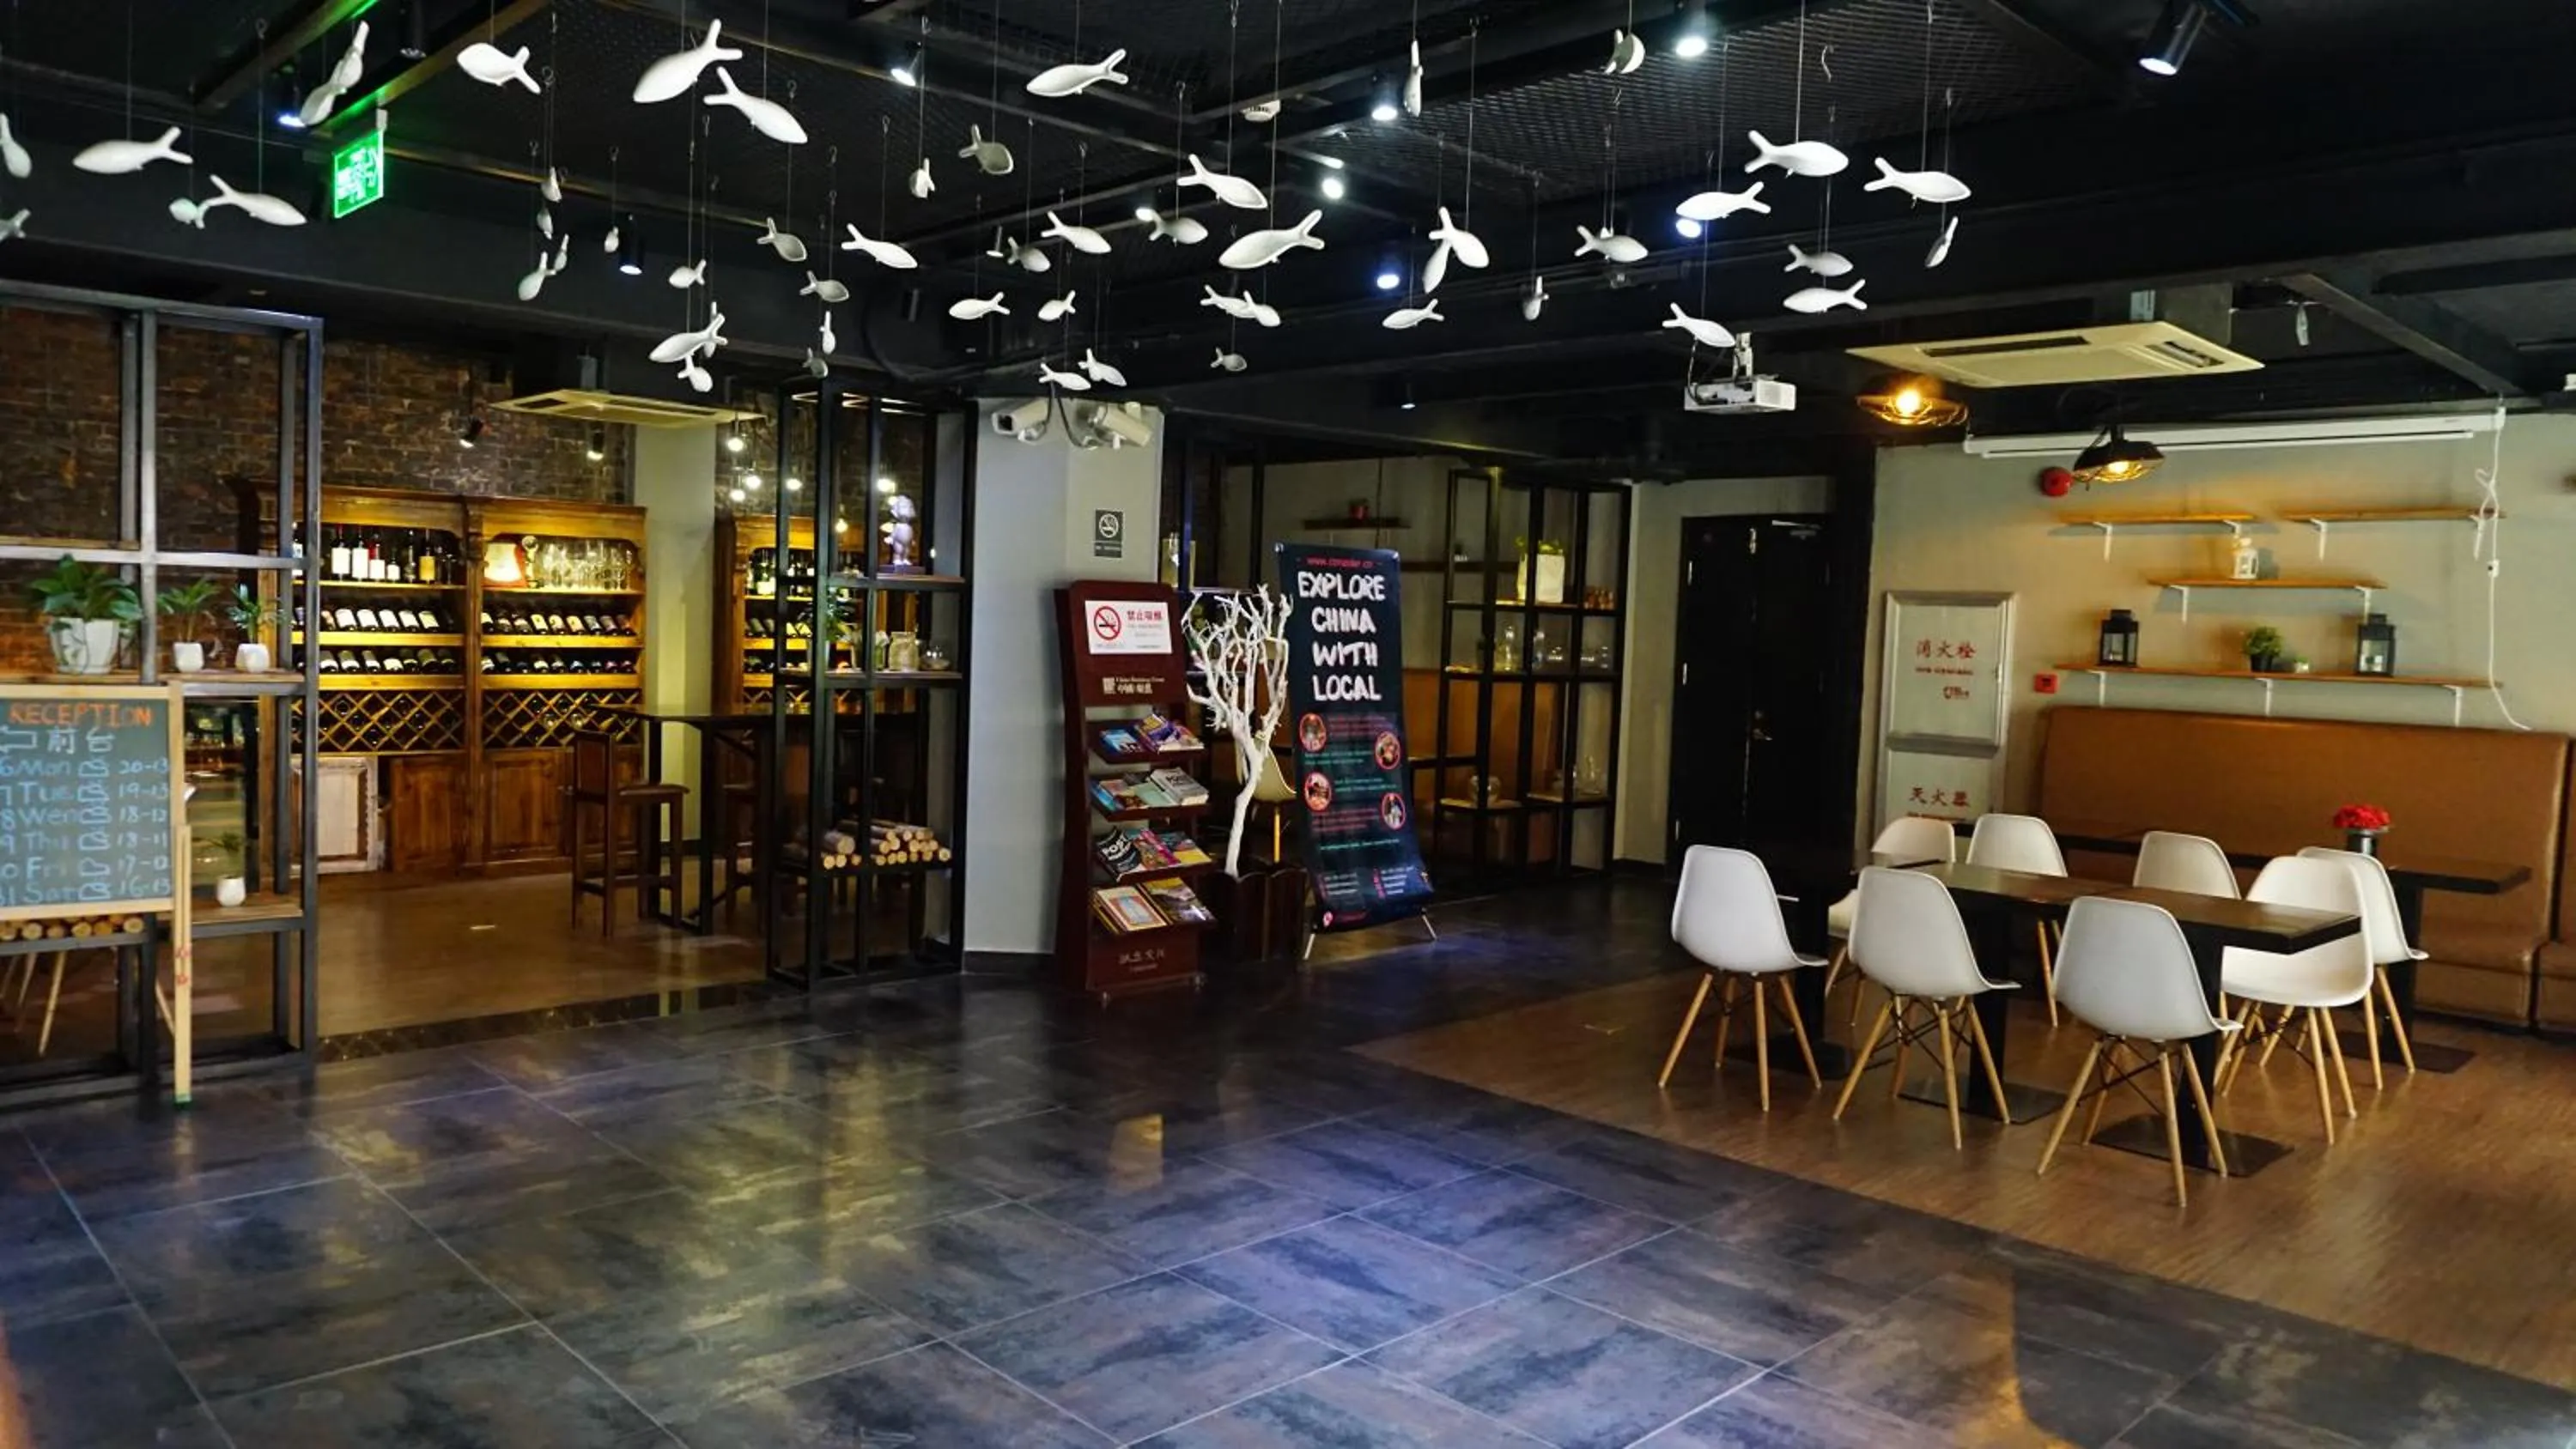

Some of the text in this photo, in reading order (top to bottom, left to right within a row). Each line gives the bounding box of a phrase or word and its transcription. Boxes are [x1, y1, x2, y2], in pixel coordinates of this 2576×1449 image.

[1297, 571, 1386, 600] EXPLORE
[1311, 606, 1376, 633] CHINA
[1312, 641, 1378, 666] WITH
[1916, 640, 1976, 659] 消火栓
[1312, 674, 1382, 701] LOCAL
[9, 702, 153, 728] RECEPTION
[46, 726, 115, 754] 前台
[15, 758, 70, 776] Mon
[1909, 787, 1971, 807] 灭火器
[27, 857, 68, 879] Fri
